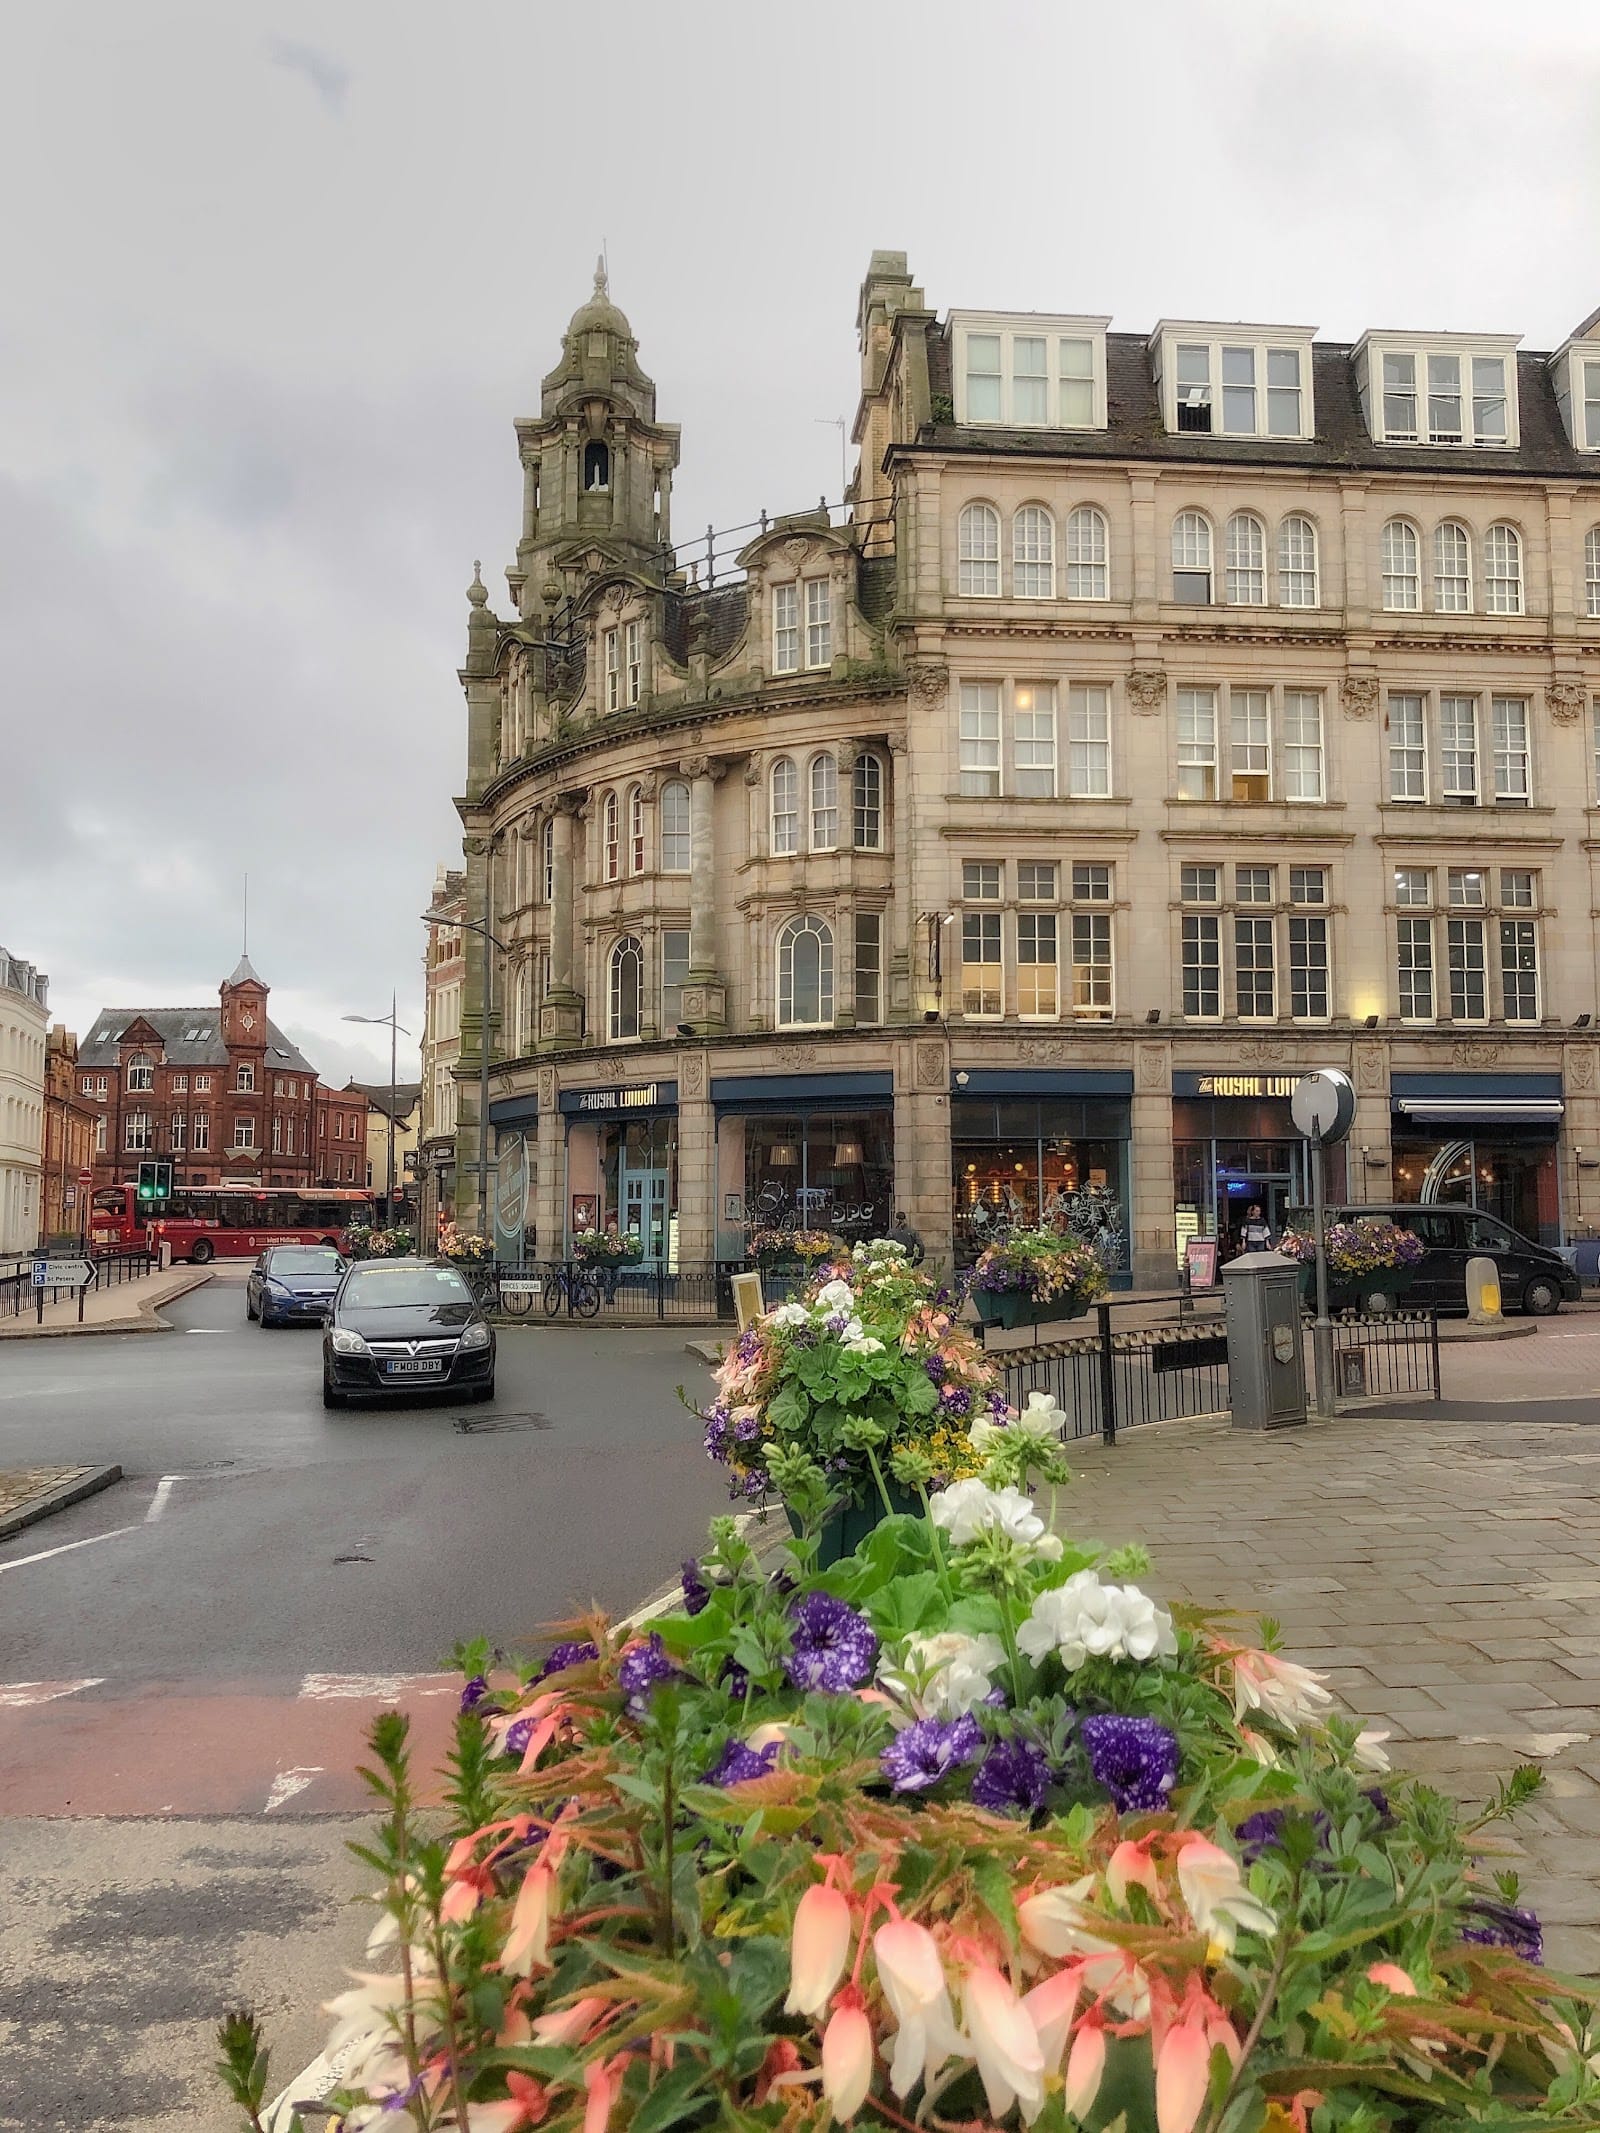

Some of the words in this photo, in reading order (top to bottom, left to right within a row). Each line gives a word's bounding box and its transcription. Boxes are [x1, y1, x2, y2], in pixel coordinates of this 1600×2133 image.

[1213, 1076, 1263, 1097] ROYAL
[1267, 1077, 1300, 1096] LON
[588, 1091, 617, 1110] ROYAL
[619, 1083, 657, 1108] LONDON
[520, 1282, 540, 1290] SQUARE
[421, 1360, 440, 1371] DBY
